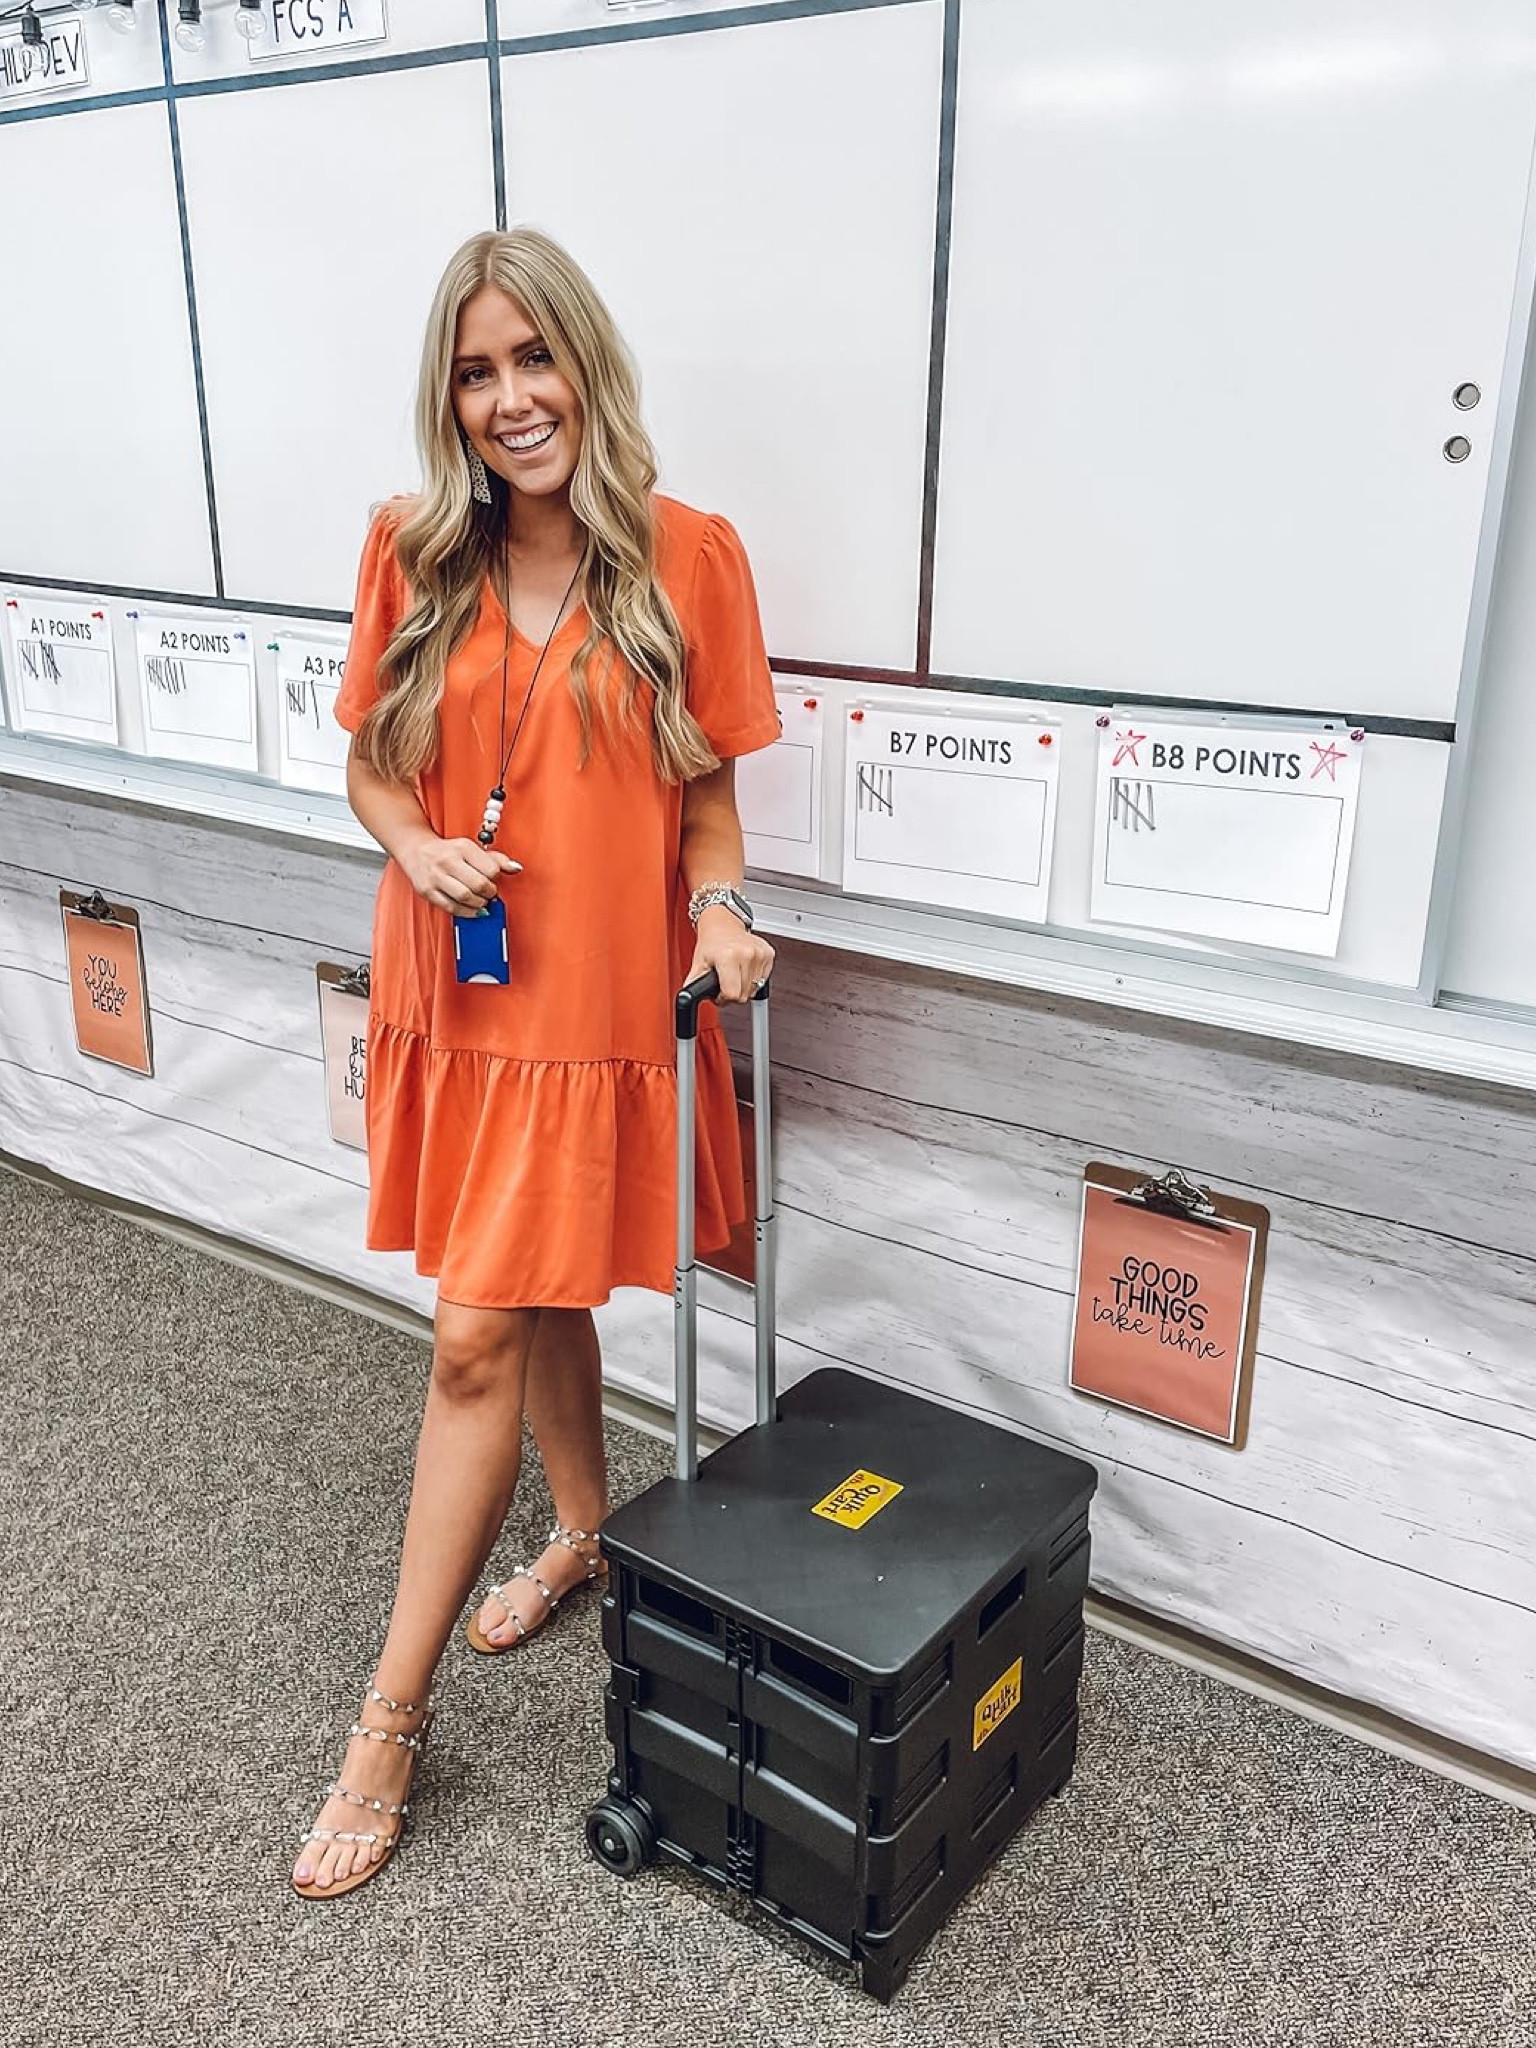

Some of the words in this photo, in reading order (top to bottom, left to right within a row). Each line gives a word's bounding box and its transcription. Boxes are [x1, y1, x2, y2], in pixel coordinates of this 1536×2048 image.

[272, 0, 324, 43] FCS
[39, 32, 79, 78] DEV
[30, 617, 46, 635] A1
[49, 619, 92, 641] POINTS
[159, 631, 178, 649] A2
[181, 632, 231, 654] POINTS
[303, 655, 324, 675] A3
[889, 731, 917, 755] B7
[925, 734, 1012, 764] POINTS
[1151, 743, 1185, 770] B8
[1195, 746, 1302, 780] POINTS
[87, 953, 117, 979] YOU
[91, 990, 122, 1017] HERE
[351, 1035, 367, 1059] BE
[1122, 1256, 1199, 1298] GOOD
[1109, 1276, 1209, 1331] THINGS
[1092, 1296, 1154, 1333] take
[1159, 1317, 1226, 1359] time
[821, 1488, 859, 1515] Cart
[840, 1484, 881, 1513] Quik
